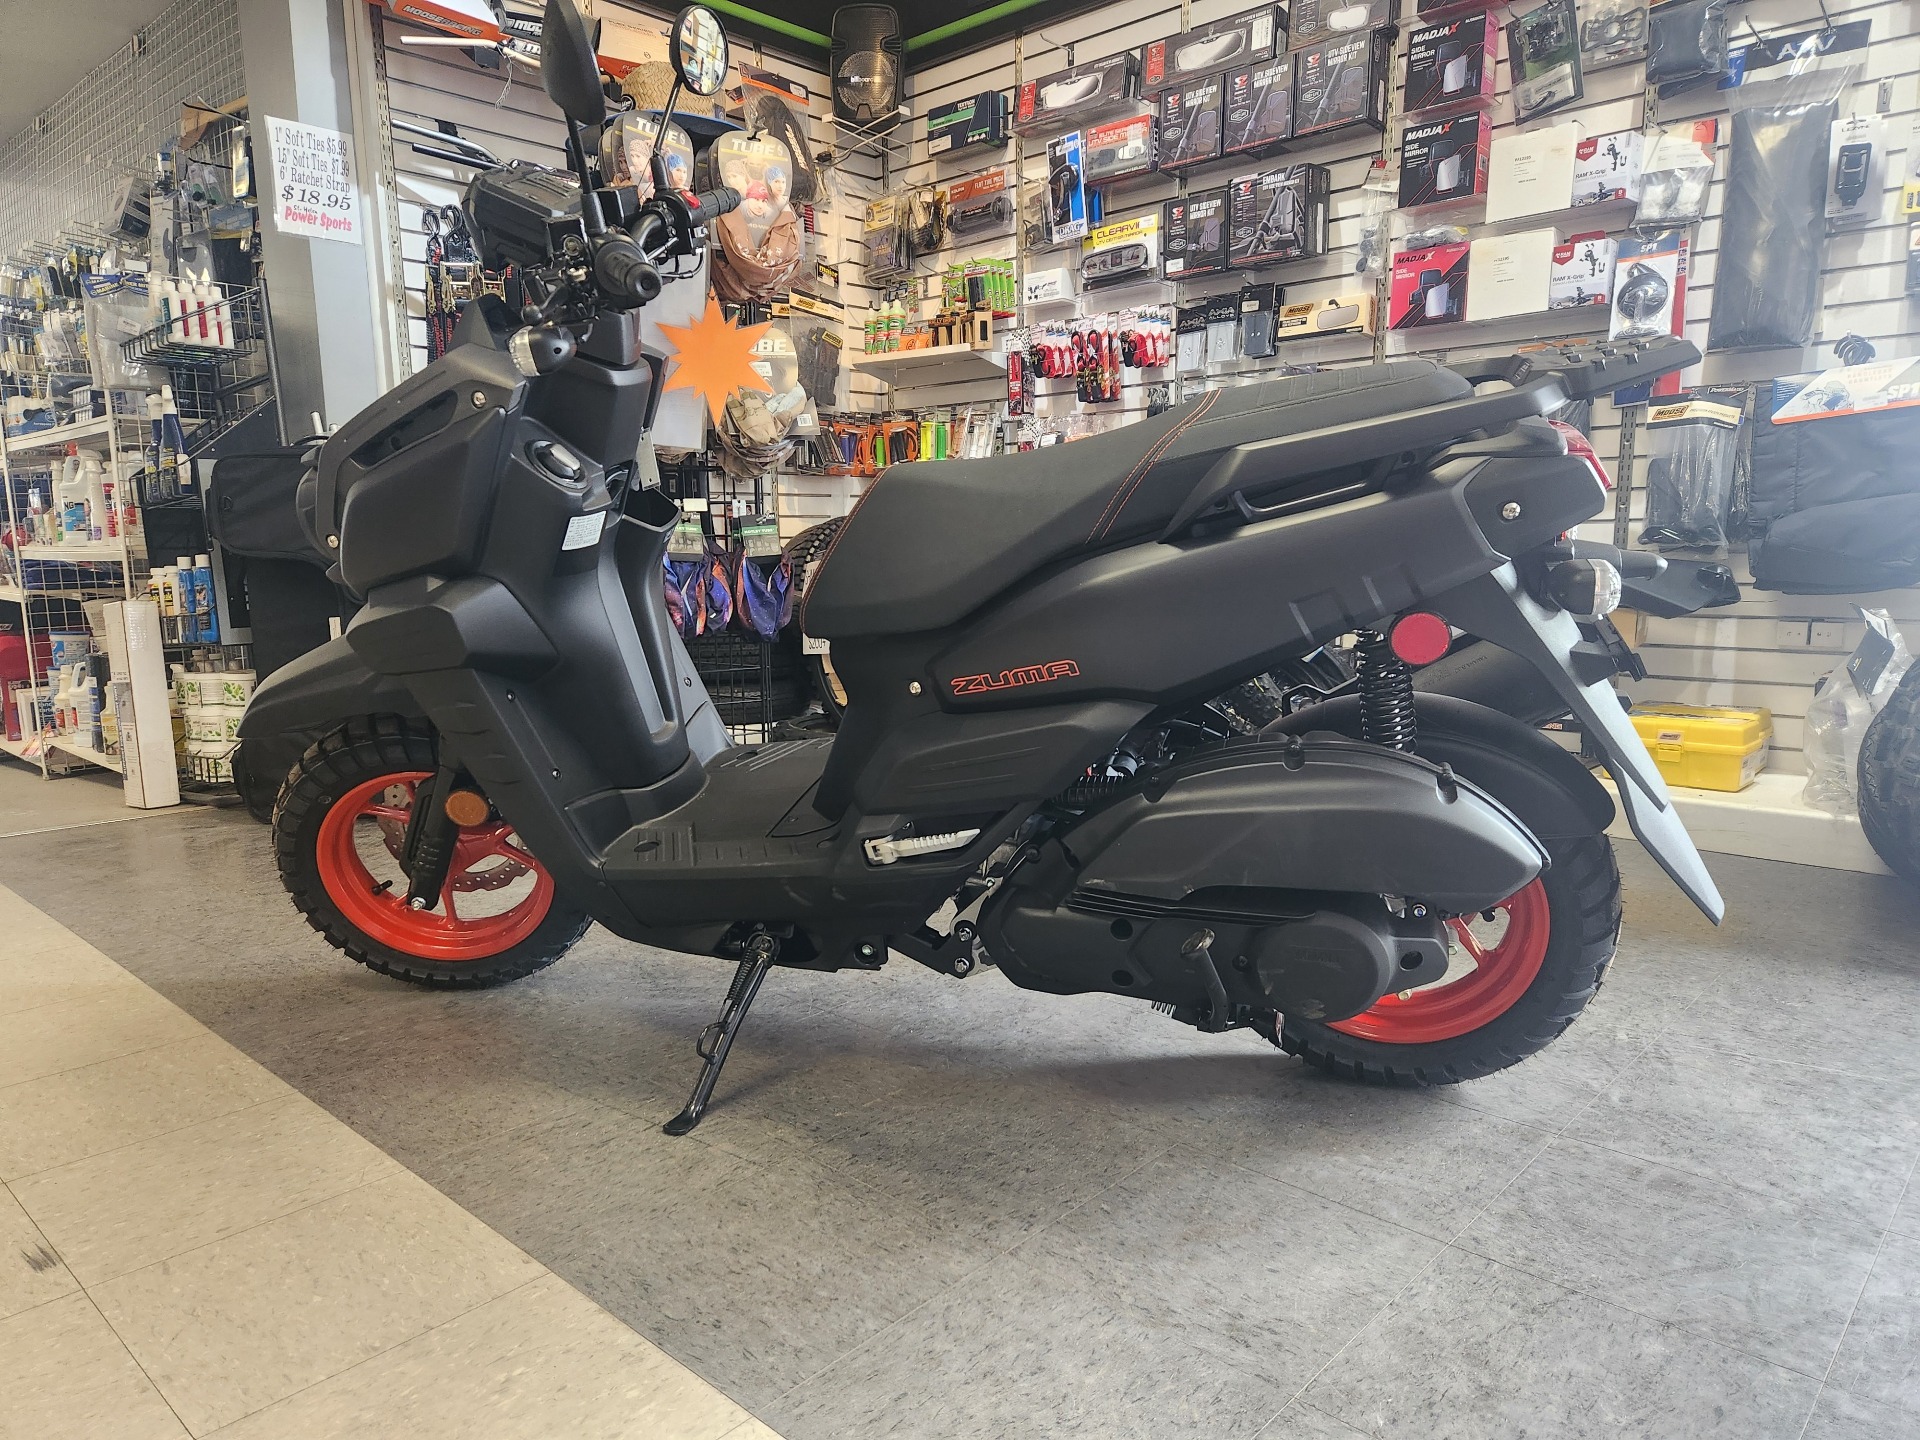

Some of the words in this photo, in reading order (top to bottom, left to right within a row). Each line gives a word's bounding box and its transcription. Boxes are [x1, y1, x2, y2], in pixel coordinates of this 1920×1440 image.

[1411, 21, 1461, 44] MADJAX
[1410, 49, 1435, 61] MIRROR
[1411, 45, 1426, 55] SIDE
[1405, 121, 1454, 141] MADJAX
[285, 127, 305, 148] Soft
[306, 132, 325, 152] Ties
[327, 136, 347, 157] $5.99
[731, 138, 776, 156] TUBE
[1405, 142, 1420, 152] SIDE
[1404, 147, 1429, 158] MIRROR
[292, 149, 309, 169] Soft
[311, 153, 327, 173] Ties
[332, 157, 350, 177] $7.99
[291, 167, 323, 188] Ratchet
[326, 174, 351, 197] Strap
[285, 205, 318, 226] Power
[320, 212, 353, 231] Sports
[1397, 251, 1435, 265] MADJAX
[819, 265, 838, 278] maier
[950, 659, 1081, 695] ZUMA
